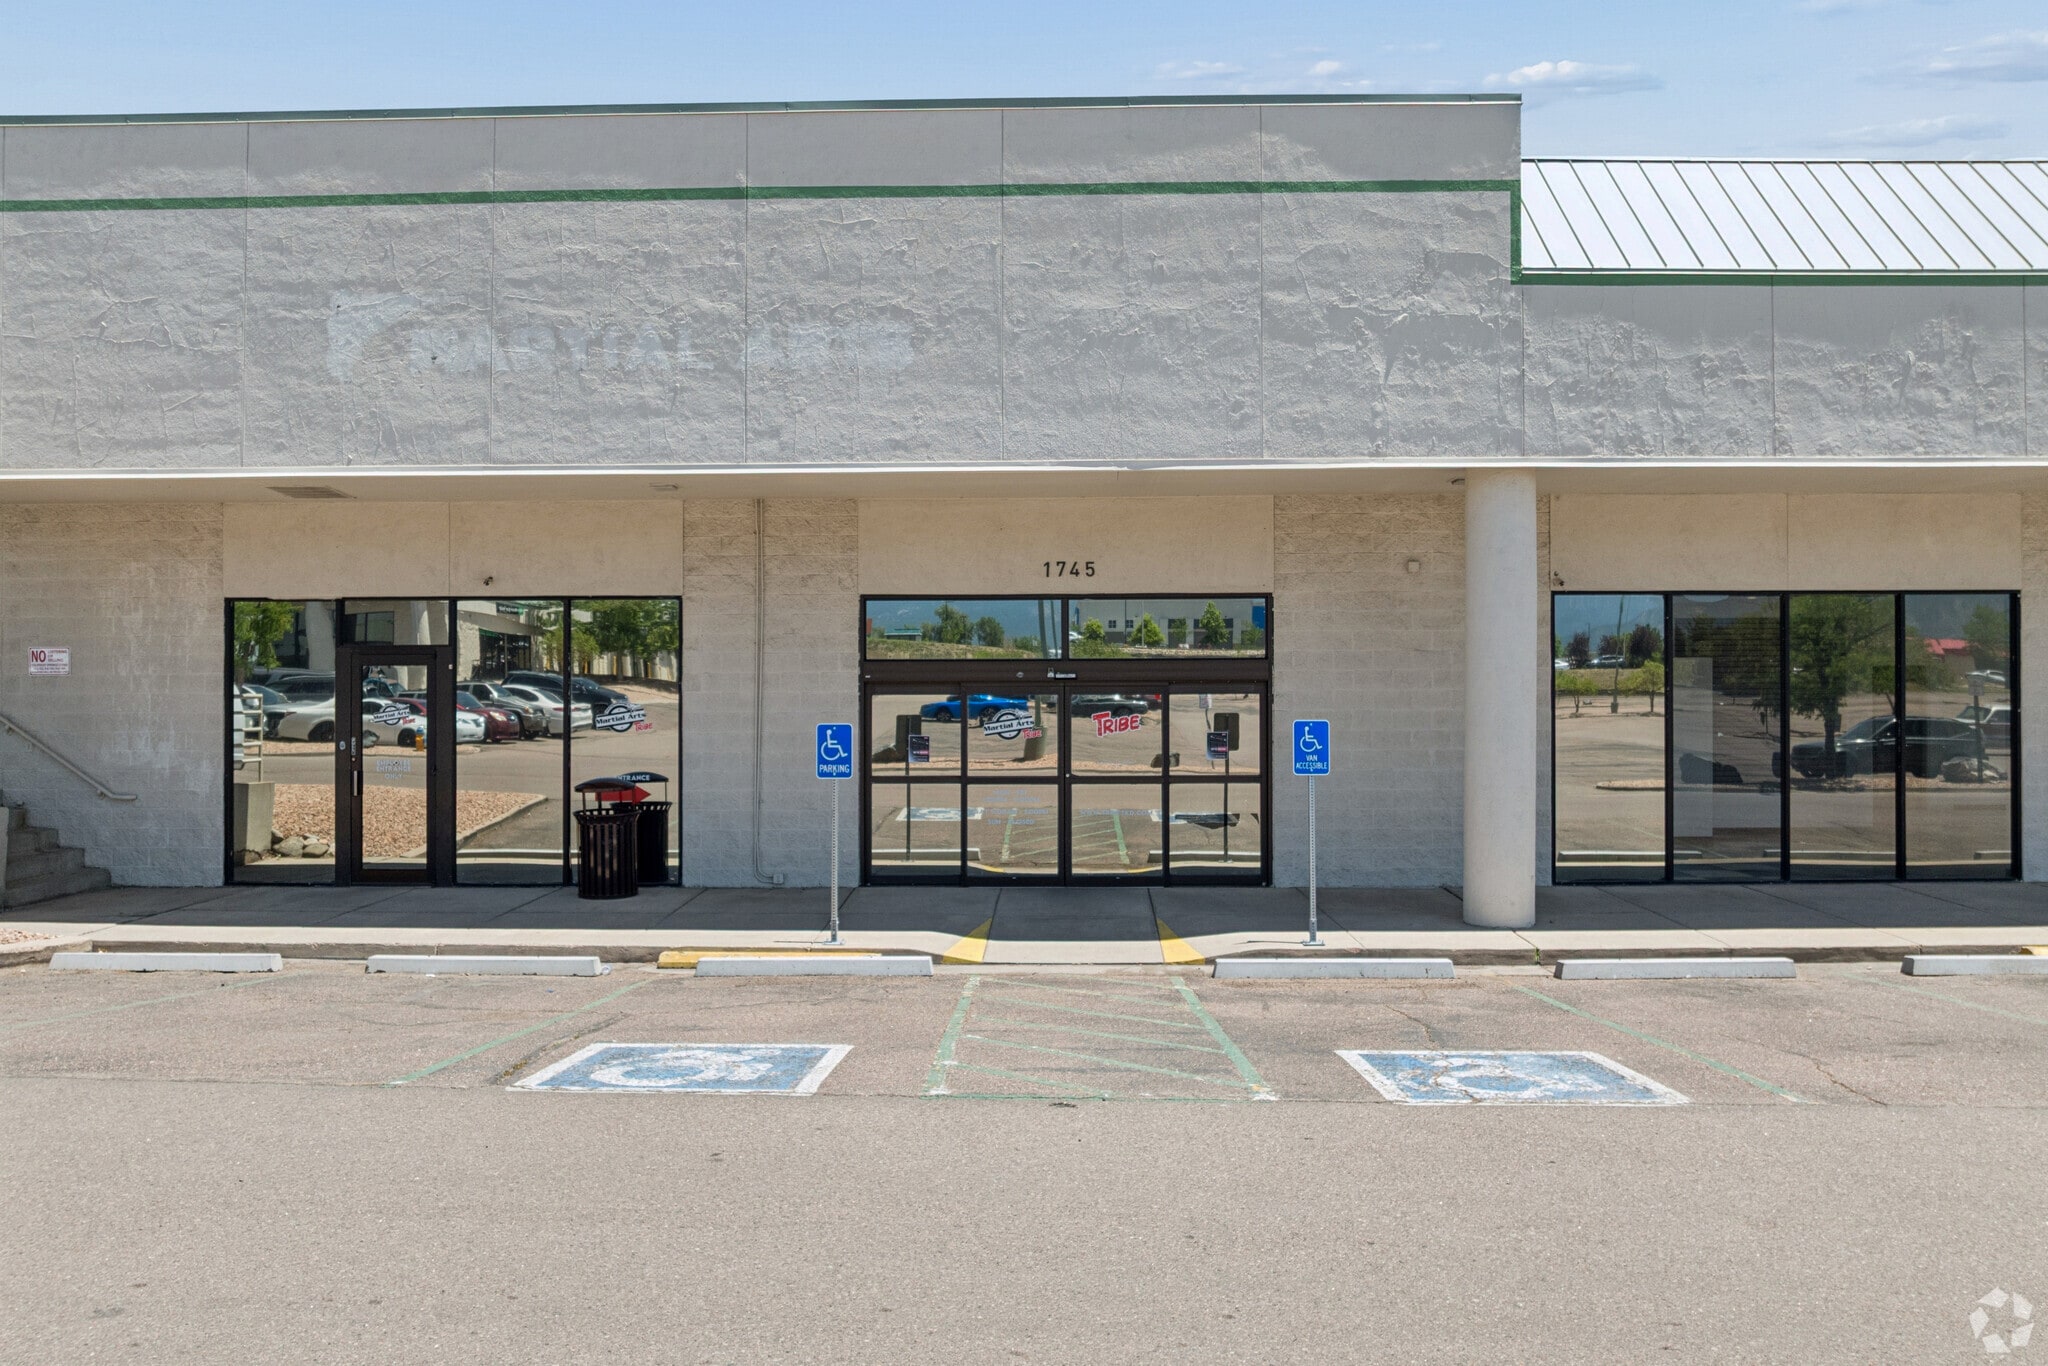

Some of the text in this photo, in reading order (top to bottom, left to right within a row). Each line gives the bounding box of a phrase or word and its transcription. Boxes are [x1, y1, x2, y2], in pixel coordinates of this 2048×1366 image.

[1043, 561, 1095, 577] 1745
[31, 650, 46, 662] NO
[373, 710, 396, 720] Martial
[595, 711, 646, 725] Martial Arts
[984, 720, 1035, 732] Martial Arts
[1092, 711, 1141, 737] TRIBE
[819, 764, 850, 773] PARKING
